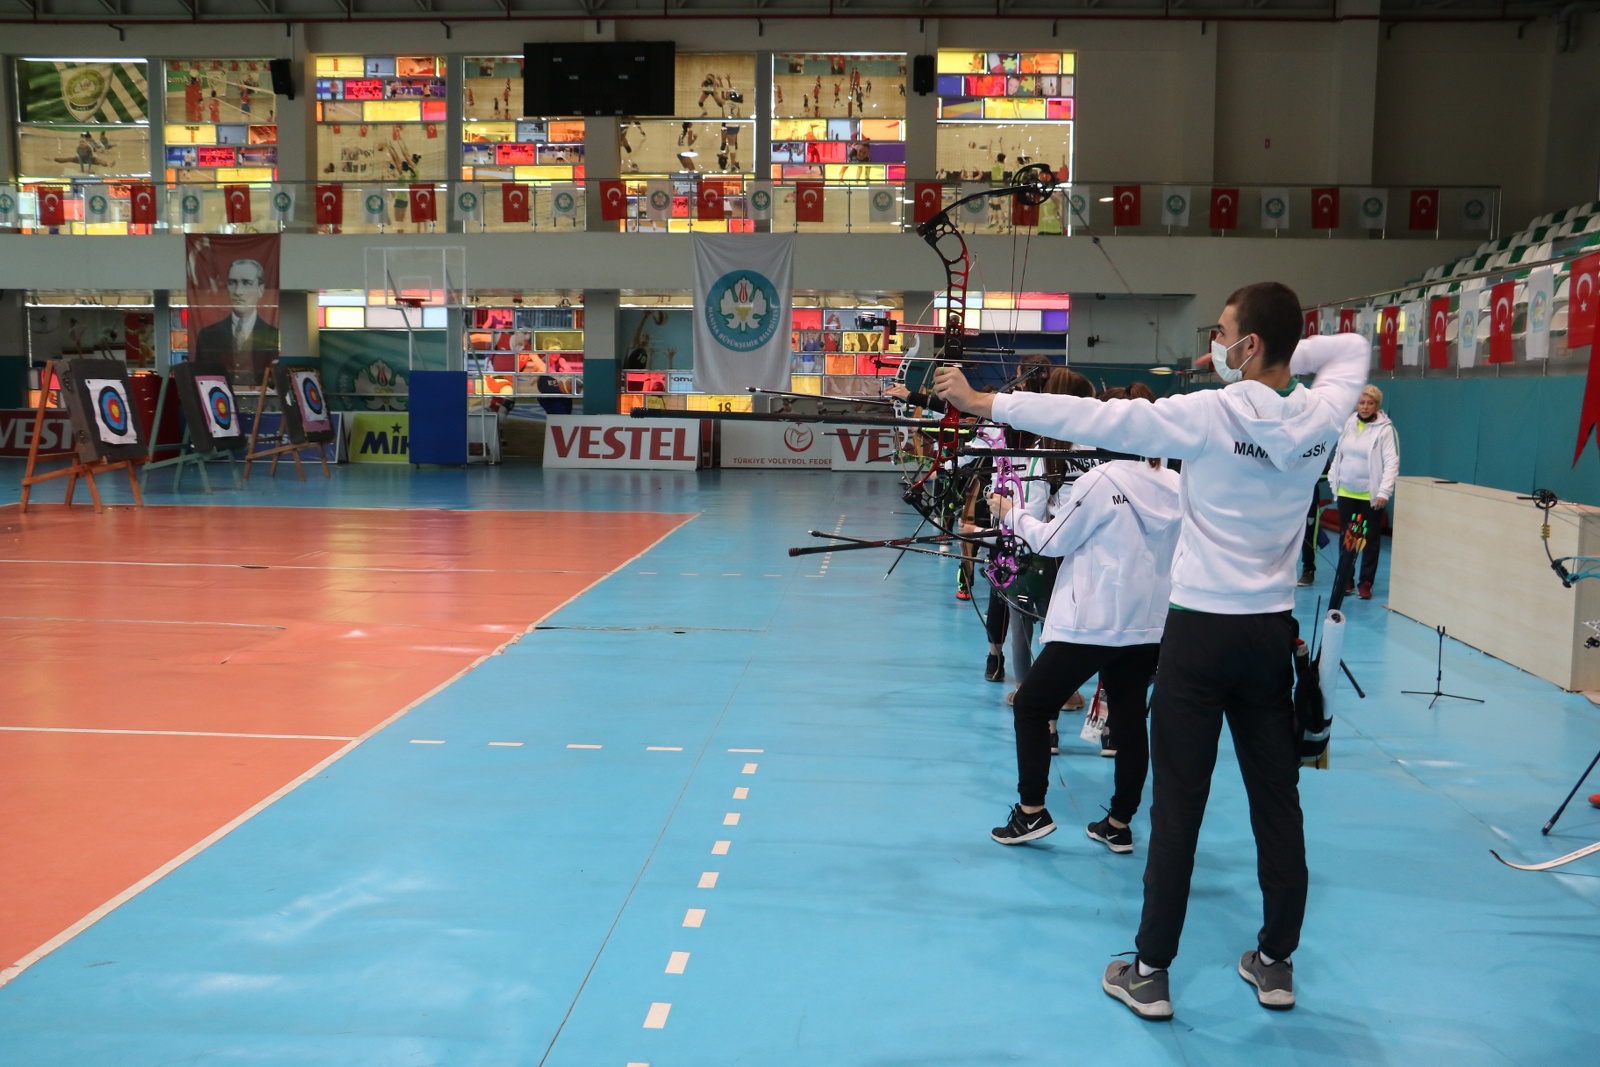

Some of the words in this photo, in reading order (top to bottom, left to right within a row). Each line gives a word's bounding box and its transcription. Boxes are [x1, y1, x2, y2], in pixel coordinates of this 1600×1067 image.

[550, 425, 696, 461] VESTEL
[733, 457, 765, 465] TÜRKİYE
[767, 457, 807, 465] VOLEYBOL
